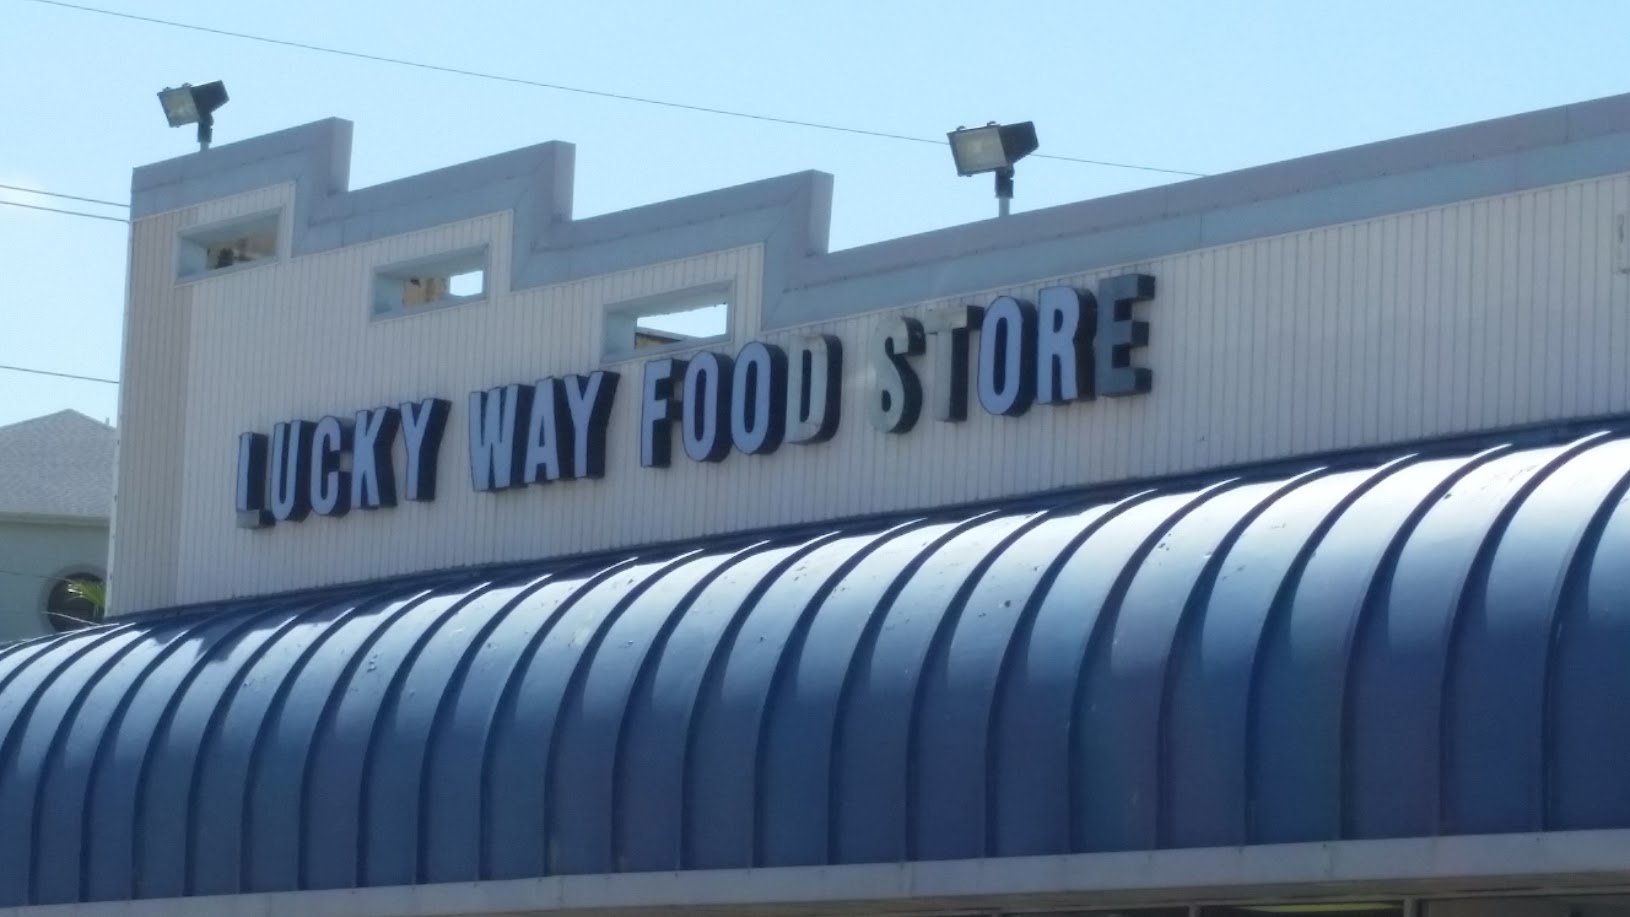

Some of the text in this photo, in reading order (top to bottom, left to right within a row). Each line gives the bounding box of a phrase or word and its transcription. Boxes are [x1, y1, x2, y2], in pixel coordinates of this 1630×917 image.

[237, 274, 1155, 528] LUCKY WAY FOOD STORE
